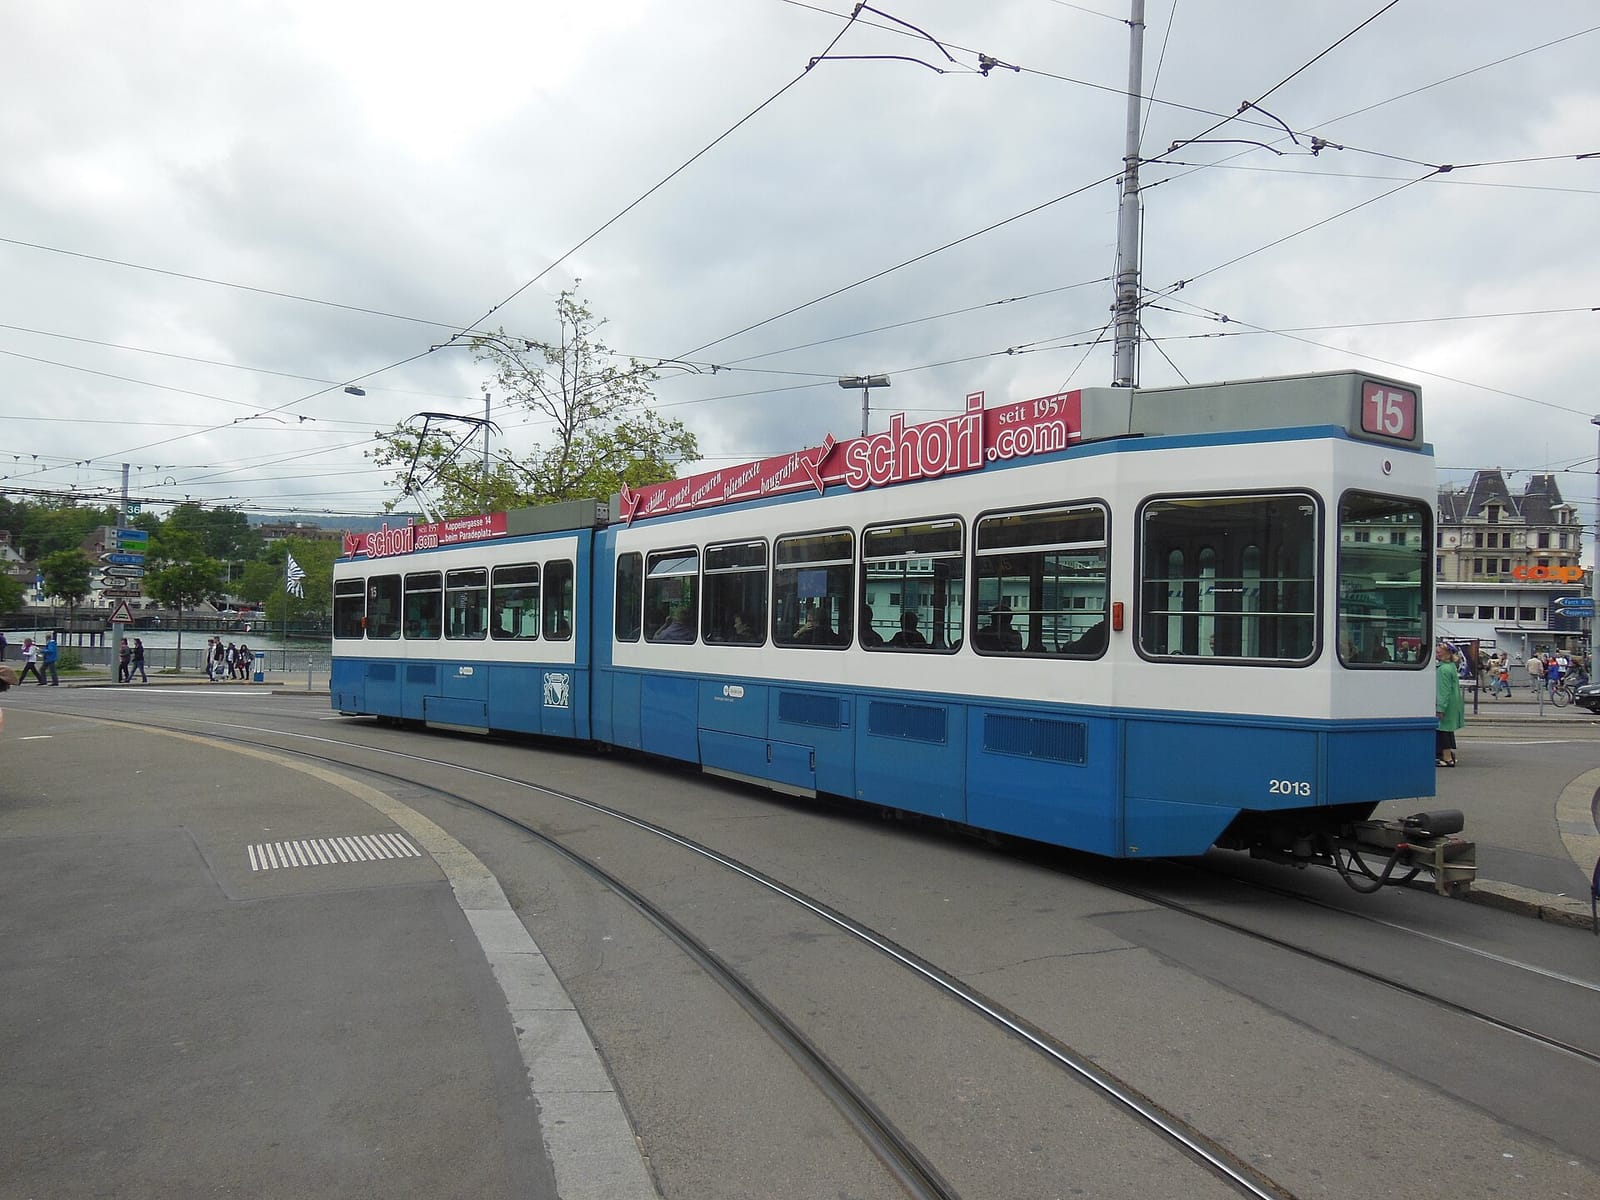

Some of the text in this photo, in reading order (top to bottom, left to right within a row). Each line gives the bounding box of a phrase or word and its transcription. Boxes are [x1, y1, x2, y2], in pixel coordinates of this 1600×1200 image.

[998, 395, 1068, 425] seit 1957
[1371, 390, 1404, 434] 15
[723, 462, 761, 502] folientexte
[760, 453, 800, 495] baugrafik
[127, 505, 141, 514] 36
[644, 488, 667, 514] schilder
[445, 515, 491, 531] Kappelergasse 14
[445, 528, 491, 542] beim Paradeplatz
[1512, 565, 1584, 585] coop
[1269, 779, 1311, 796] 2013
